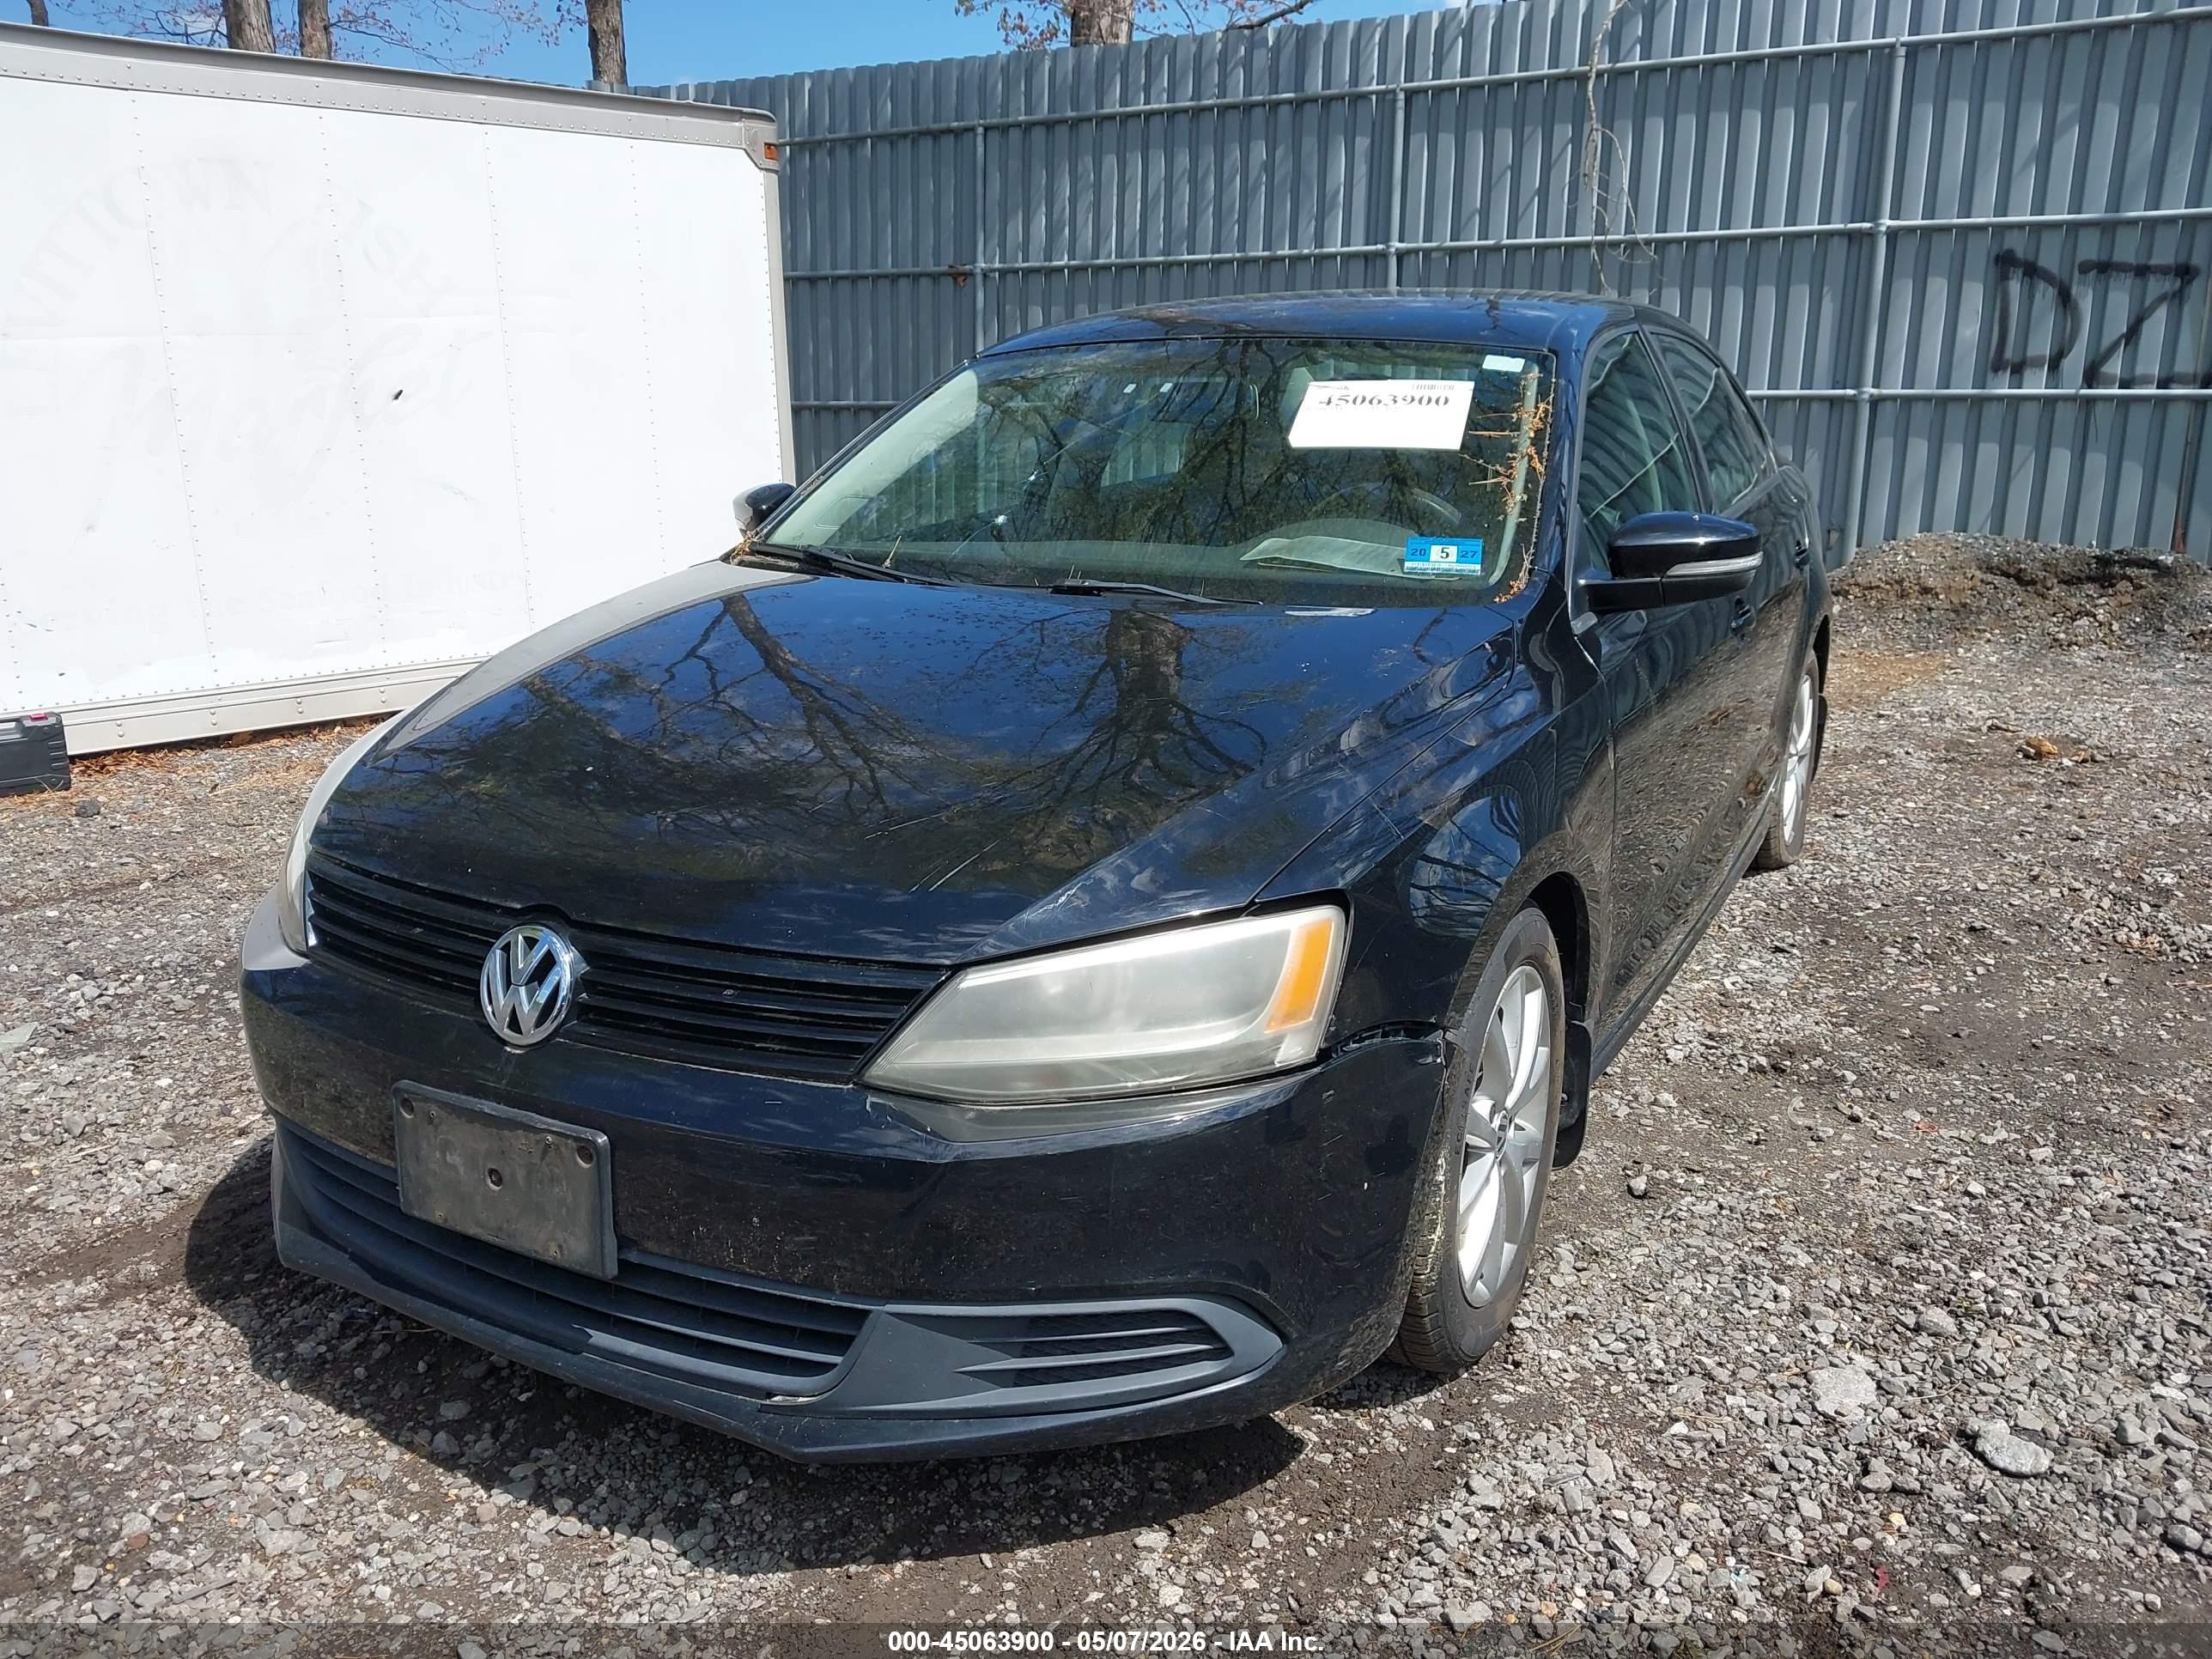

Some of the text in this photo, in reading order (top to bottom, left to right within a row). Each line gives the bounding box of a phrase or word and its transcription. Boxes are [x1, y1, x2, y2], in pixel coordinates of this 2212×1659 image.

[1990, 248, 2212, 387] DZ
[1318, 394, 1450, 406] 45063900
[1411, 549, 1426, 557] 20
[1440, 546, 1450, 559] 5
